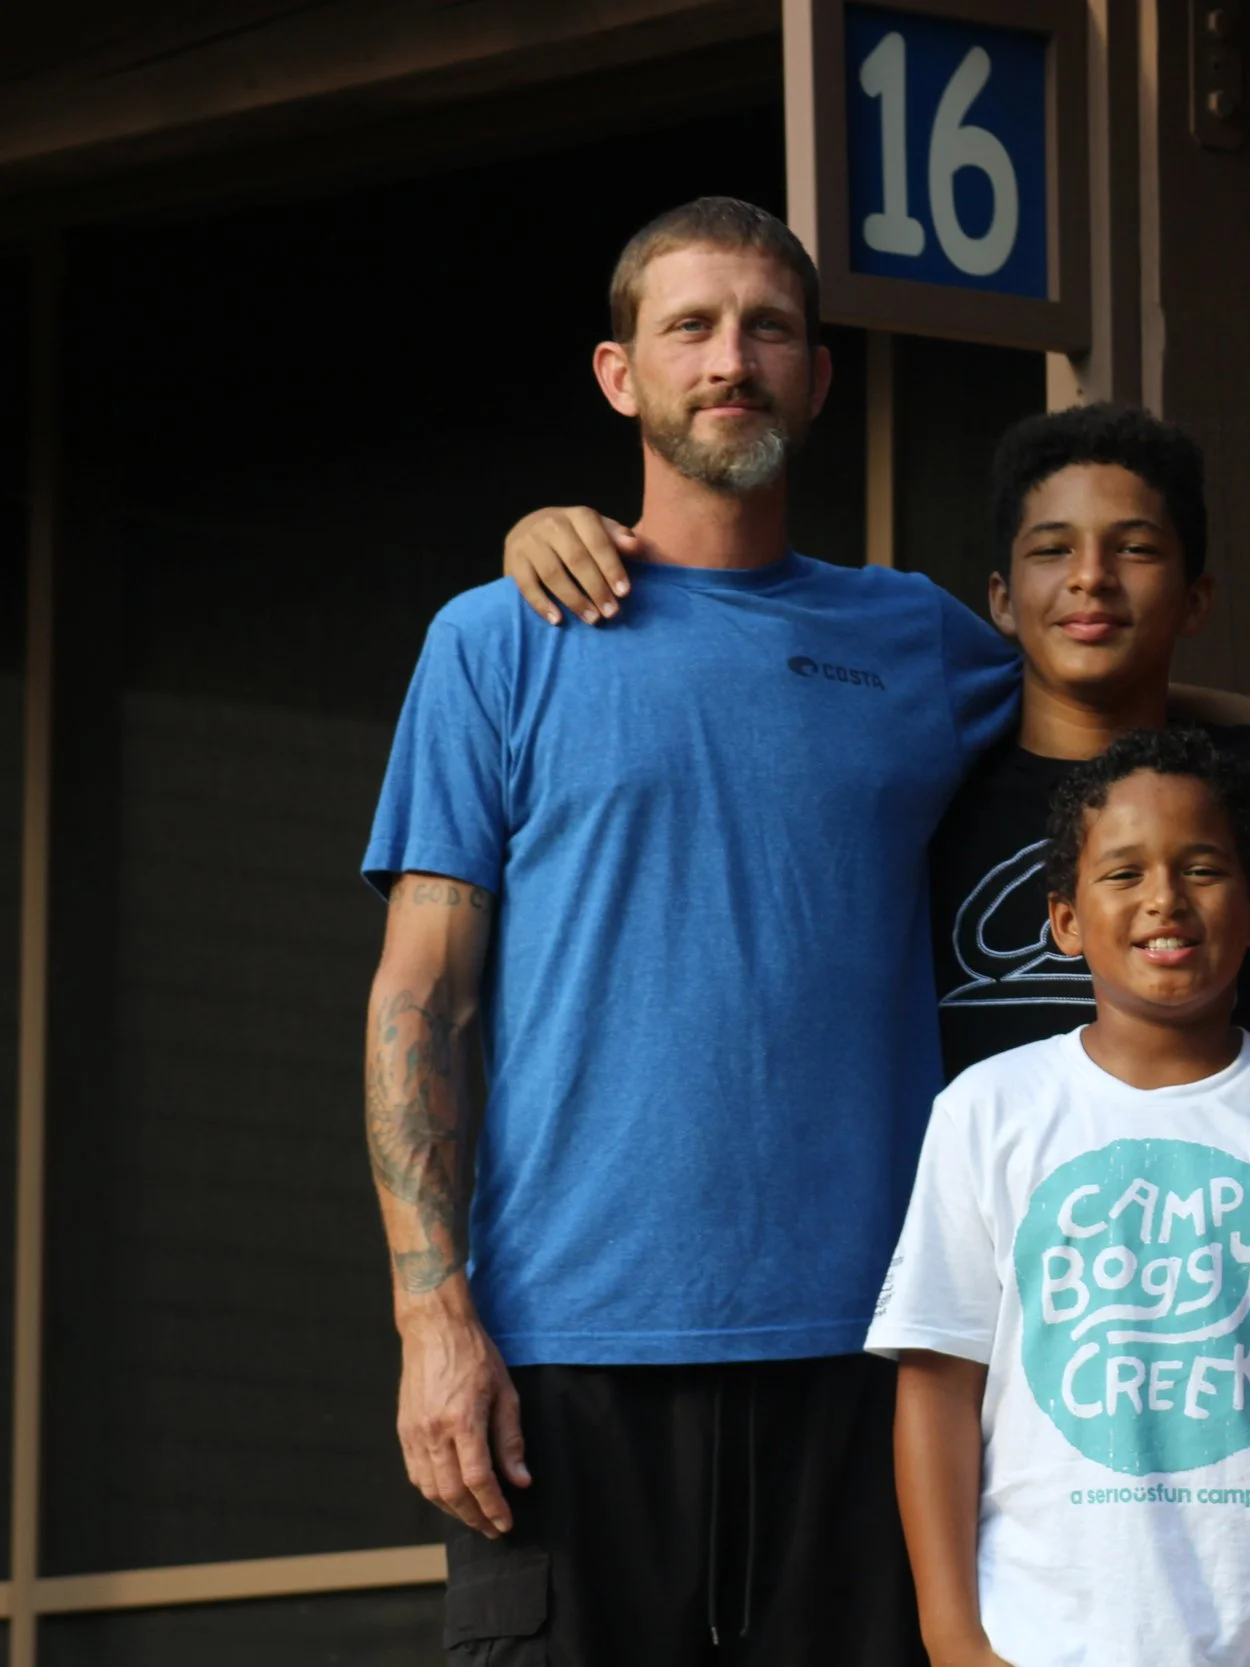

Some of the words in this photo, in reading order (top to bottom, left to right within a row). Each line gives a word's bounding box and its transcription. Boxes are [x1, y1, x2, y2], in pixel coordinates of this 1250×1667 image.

[859, 31, 1019, 276] 16
[822, 662, 886, 691] COSTA
[1057, 1177, 1244, 1244] CAMP
[1070, 1490, 1083, 1505] a
